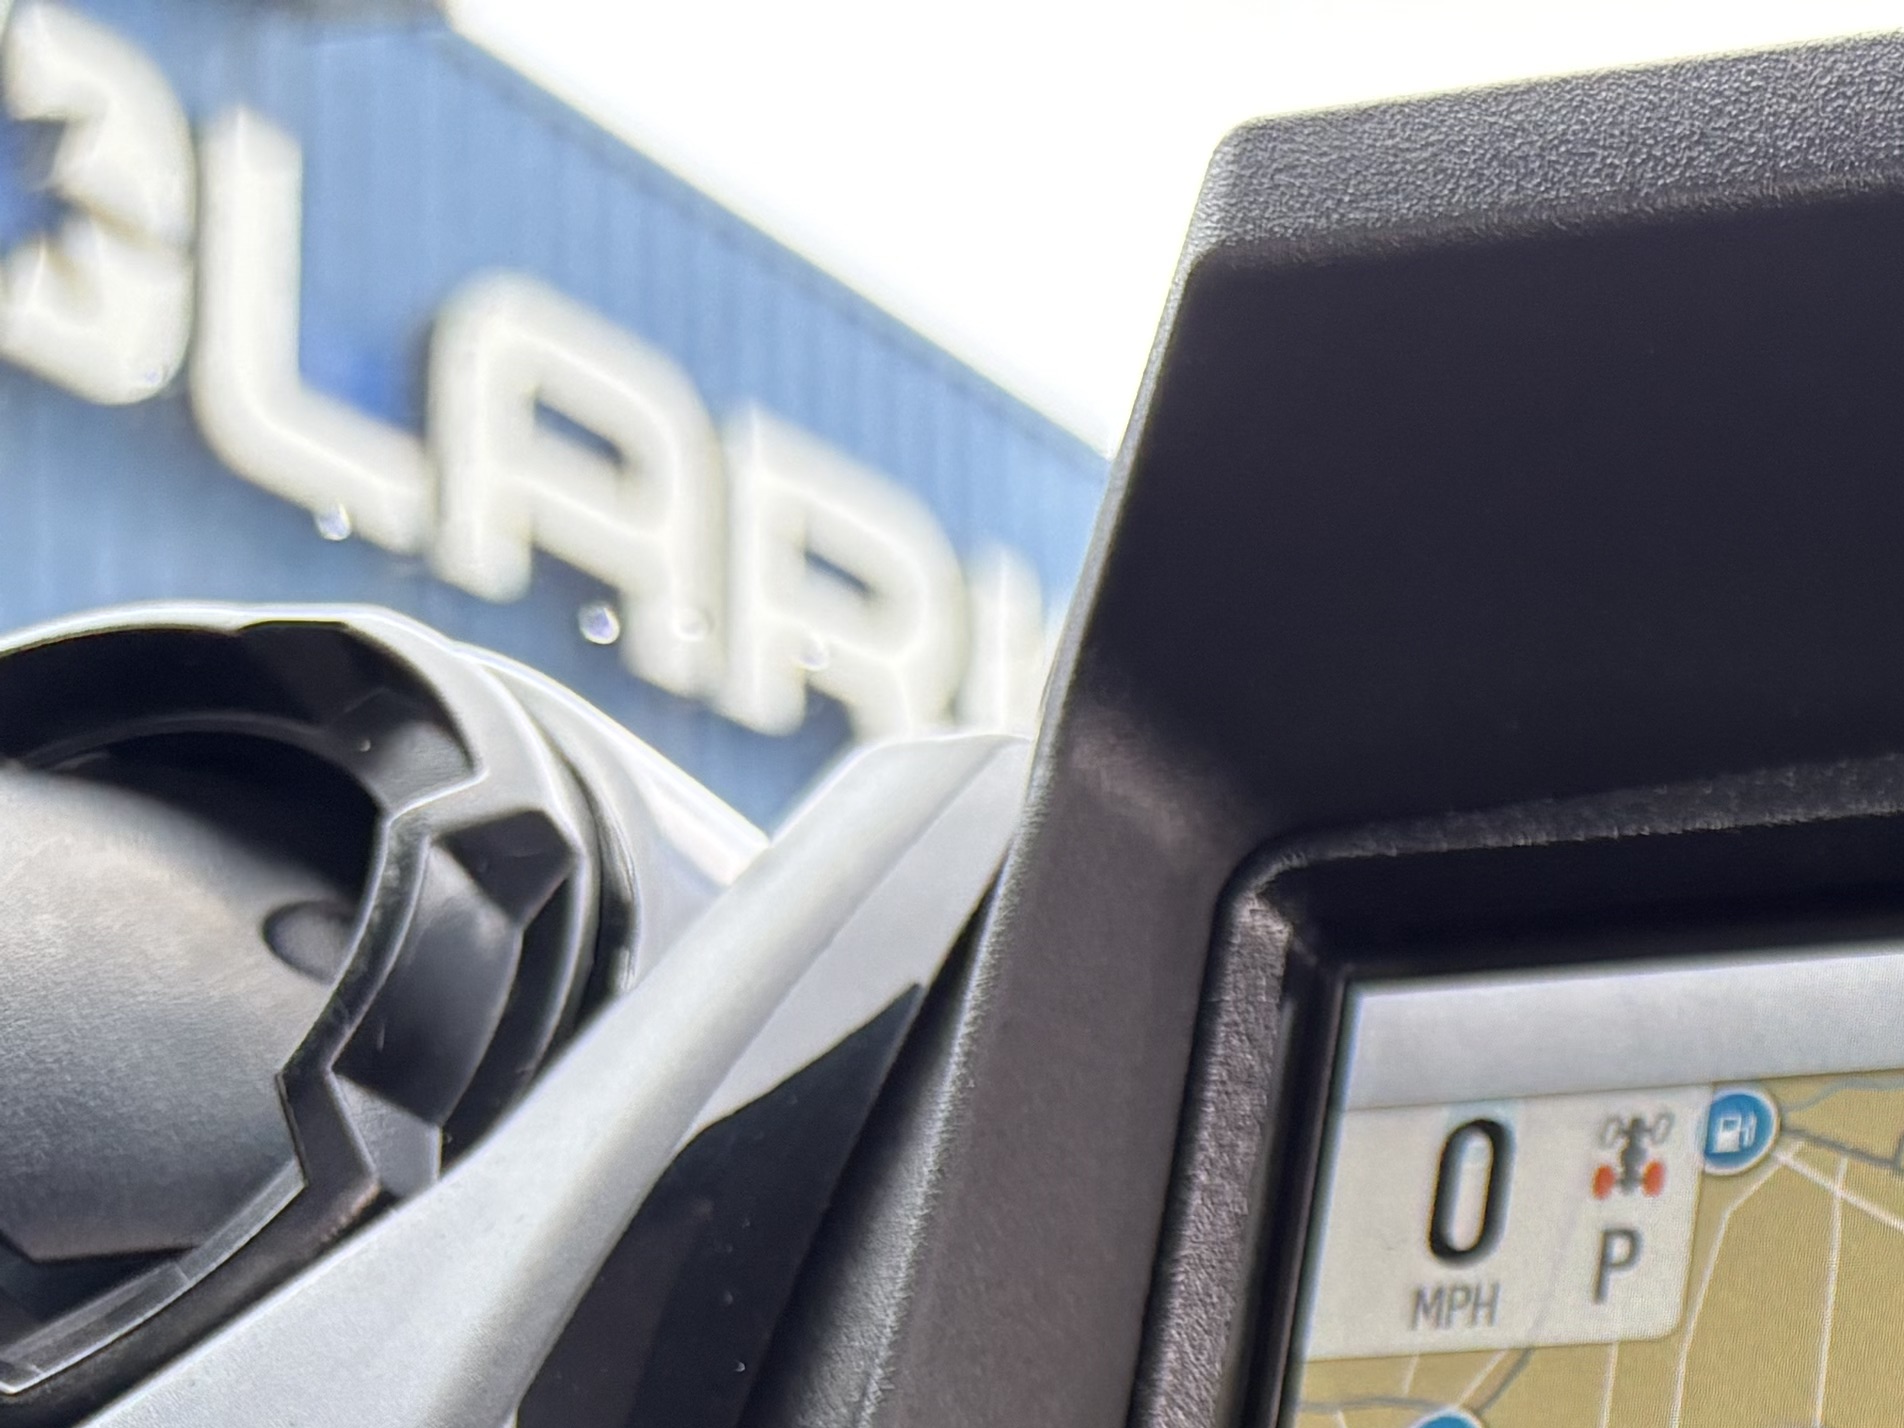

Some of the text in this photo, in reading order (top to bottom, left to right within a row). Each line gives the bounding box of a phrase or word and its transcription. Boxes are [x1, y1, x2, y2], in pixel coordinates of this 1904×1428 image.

[1427, 1116, 1511, 1269] 0
[1592, 1227, 1643, 1305] P
[1408, 1280, 1501, 1332] MPH
